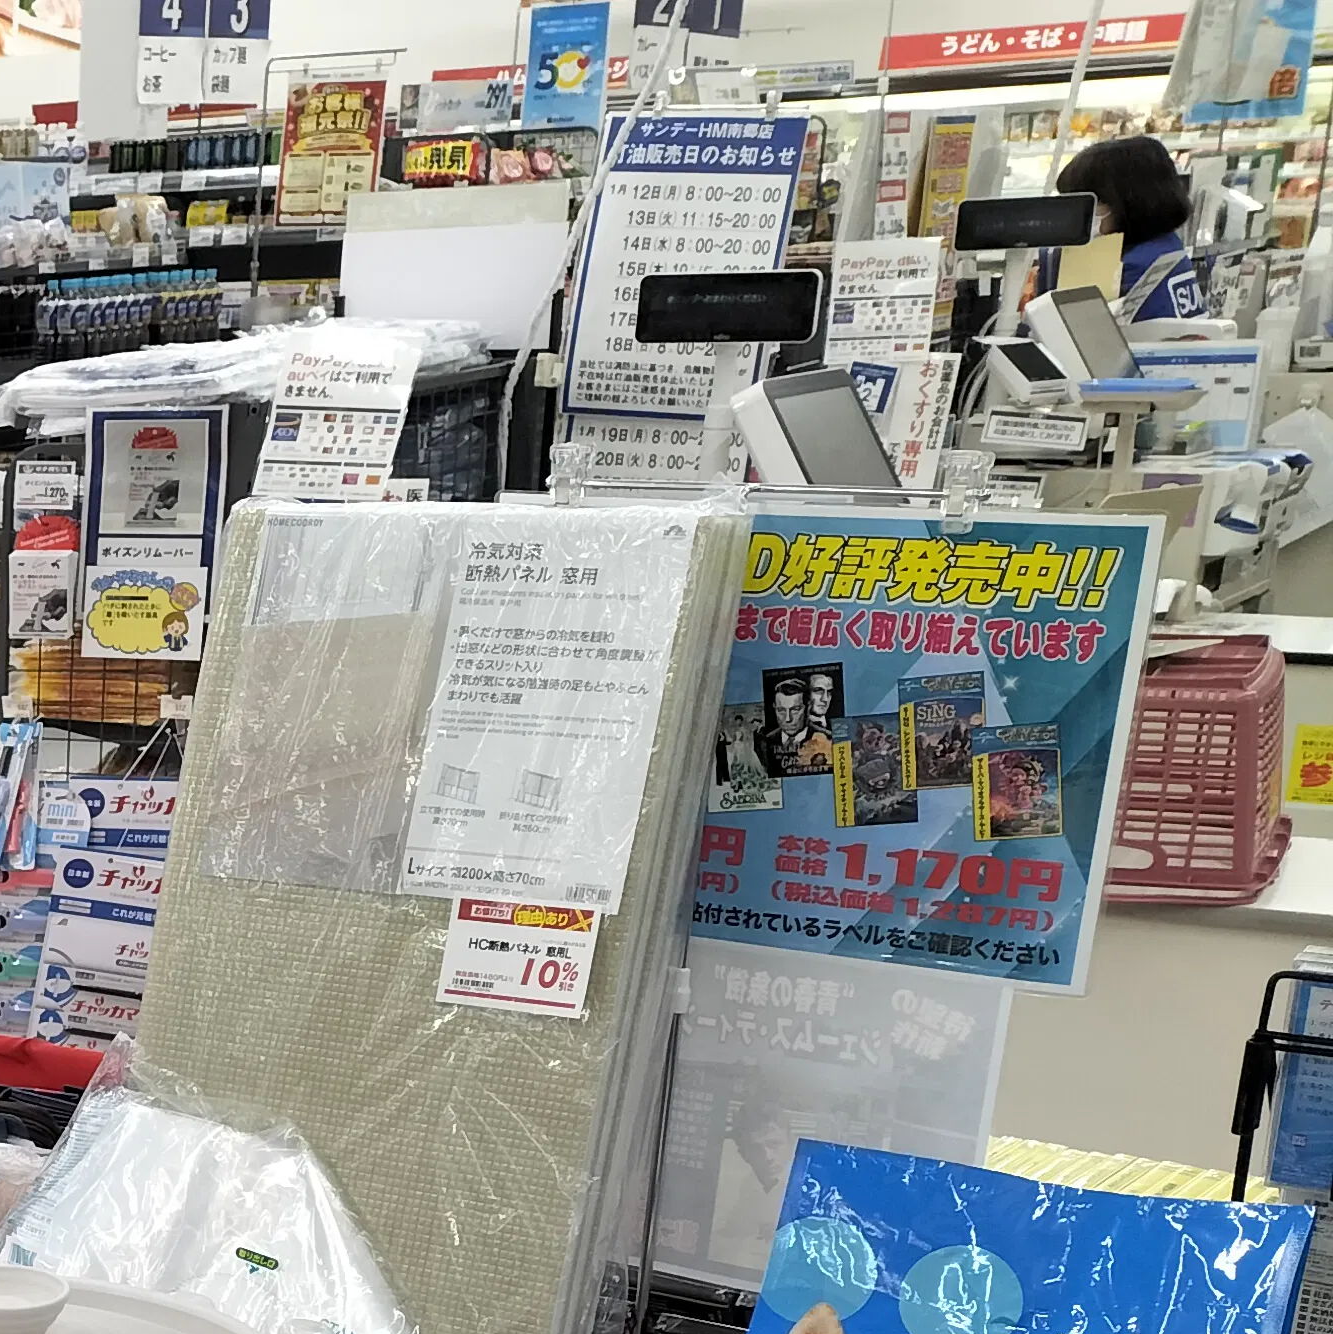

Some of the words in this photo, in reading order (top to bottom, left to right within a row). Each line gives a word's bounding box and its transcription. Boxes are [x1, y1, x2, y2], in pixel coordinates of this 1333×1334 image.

[162, 0, 182, 31] 4
[940, 20, 1148, 56] うどん・そば・中華麺
[144, 47, 176, 62] コーヒー
[143, 75, 163, 93] お茶
[641, 123, 775, 140] サンデーHM南郷店
[611, 184, 627, 195] 1月
[633, 185, 681, 201] 12日(月)
[686, 186, 781, 203] 8:00~20:00
[628, 211, 677, 226] 13日(火)
[682, 212, 776, 229] 11:15~20:00
[623, 236, 672, 251] 14日(水)
[676, 238, 770, 255] 8:00~20:00
[841, 258, 892, 270] PayPay
[287, 370, 392, 385] auペイはご利用で
[284, 385, 333, 399] きません。
[927, 360, 957, 451] 医薬品のお会計は
[900, 360, 937, 478] おくすり専用
[601, 428, 647, 443] 19日(月)
[596, 452, 644, 467] 20日(火)
[102, 547, 194, 558] ポイズンリムーバー
[469, 542, 544, 561] 冷気対策
[465, 564, 553, 583] 断熱パネル
[560, 567, 598, 586] 窓用
[741, 531, 1123, 610] D好評発売中!!
[735, 605, 1106, 662] まで幅広く取り揃えています
[916, 703, 956, 721] SING
[47, 801, 78, 818] mini
[778, 836, 829, 857] 本体
[407, 857, 445, 876] Lサイズ
[775, 855, 827, 876] 価格
[835, 844, 1063, 901] 1,170円
[771, 882, 1054, 931] (税込価格1,287円)
[517, 909, 569, 926] 理由あり
[468, 937, 541, 956] HC断熱パネル
[546, 945, 572, 959] 窓用L
[520, 957, 578, 988] 10%
